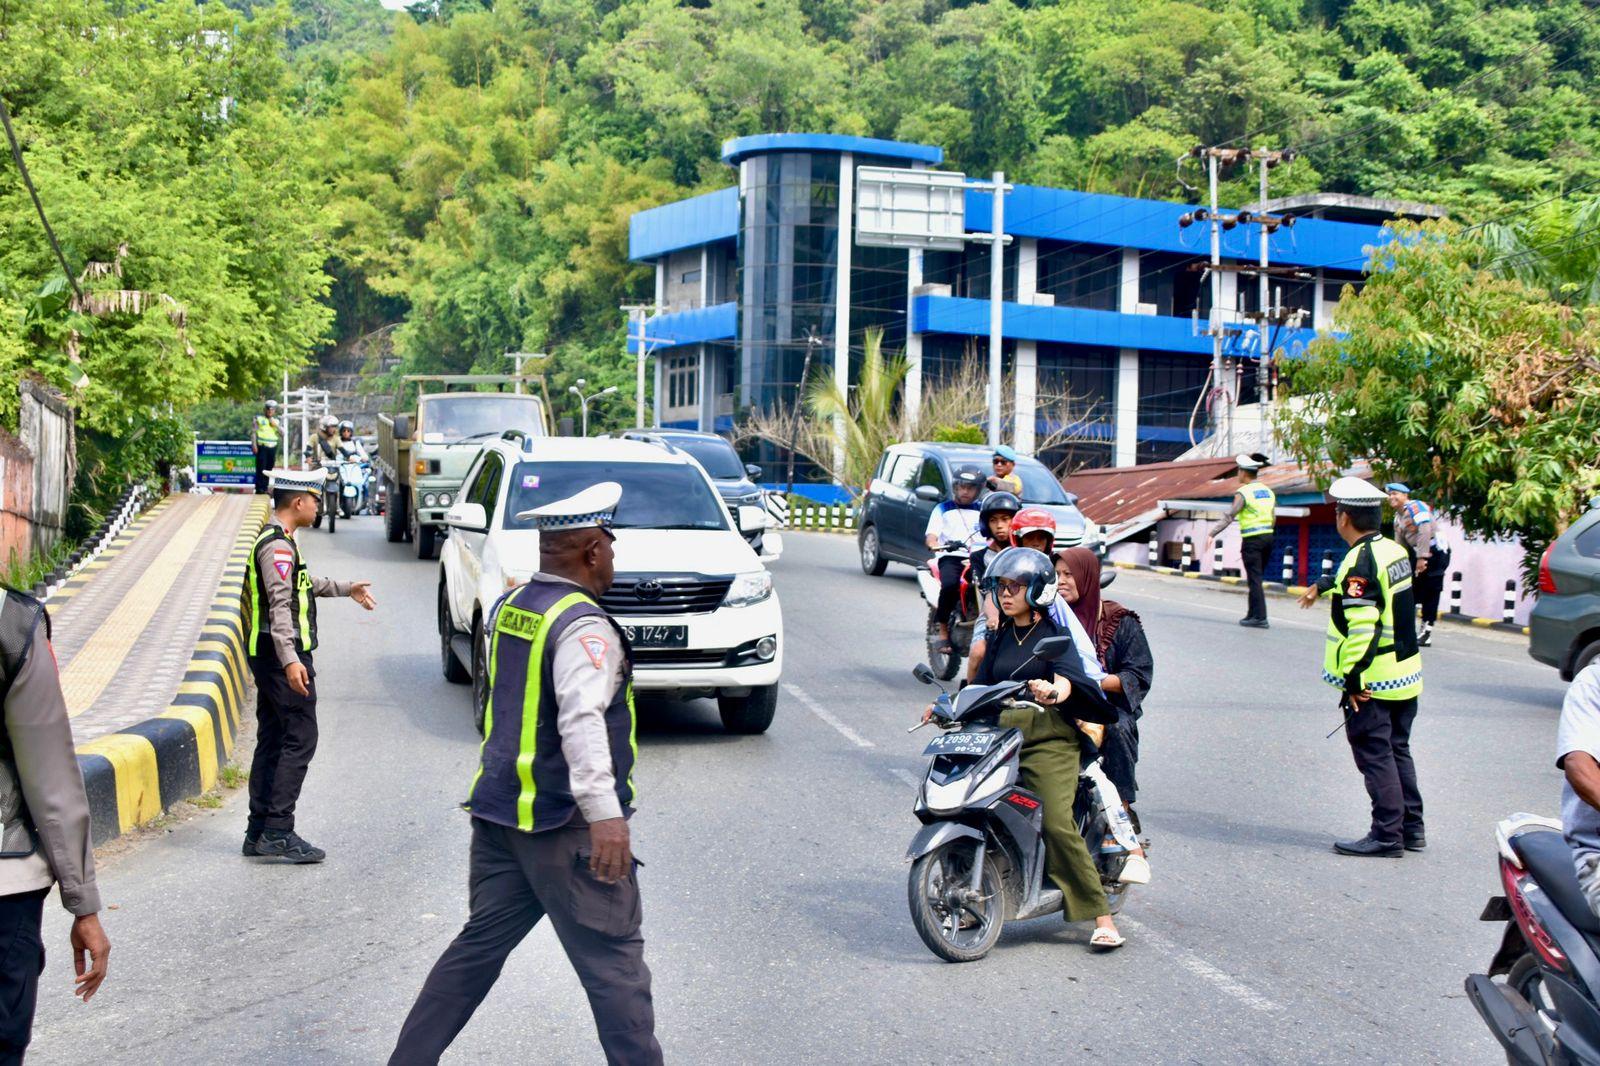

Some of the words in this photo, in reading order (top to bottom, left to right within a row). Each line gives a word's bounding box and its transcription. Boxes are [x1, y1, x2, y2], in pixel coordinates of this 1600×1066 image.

[675, 626, 685, 641] J
[930, 737, 945, 746] PA
[945, 735, 972, 744] 2098
[1007, 793, 1040, 809] 125
